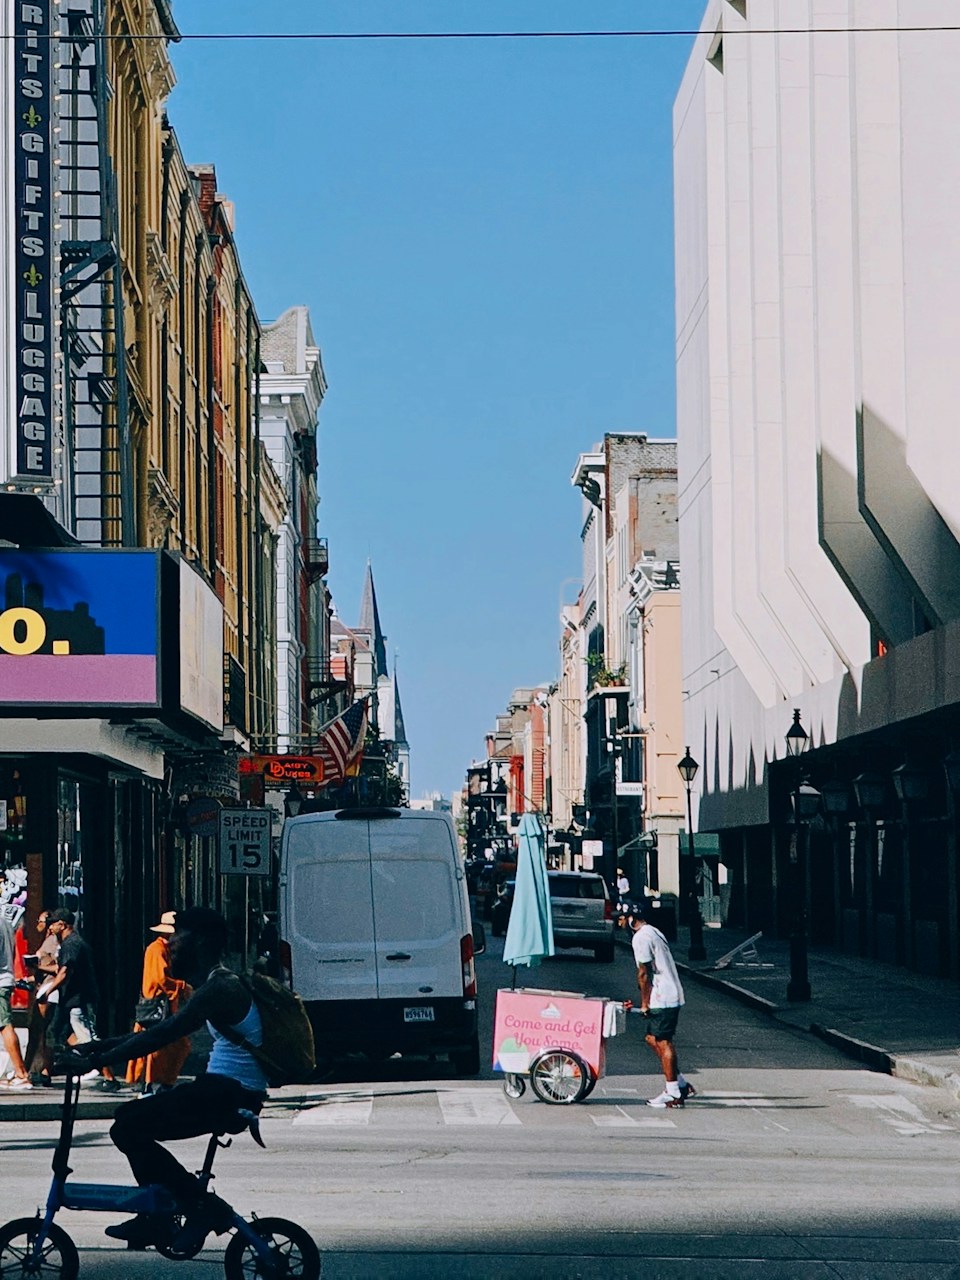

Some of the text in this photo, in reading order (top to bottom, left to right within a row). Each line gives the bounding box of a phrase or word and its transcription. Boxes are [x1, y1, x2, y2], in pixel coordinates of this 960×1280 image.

[20, 132, 45, 257] GIFTS
[20, 291, 46, 470] LUGGAGE
[223, 816, 268, 827] SPEED
[228, 830, 262, 841] LIMIT
[229, 844, 261, 869] 15
[504, 1015, 597, 1038] Come and Get
[514, 1032, 540, 1048] You
